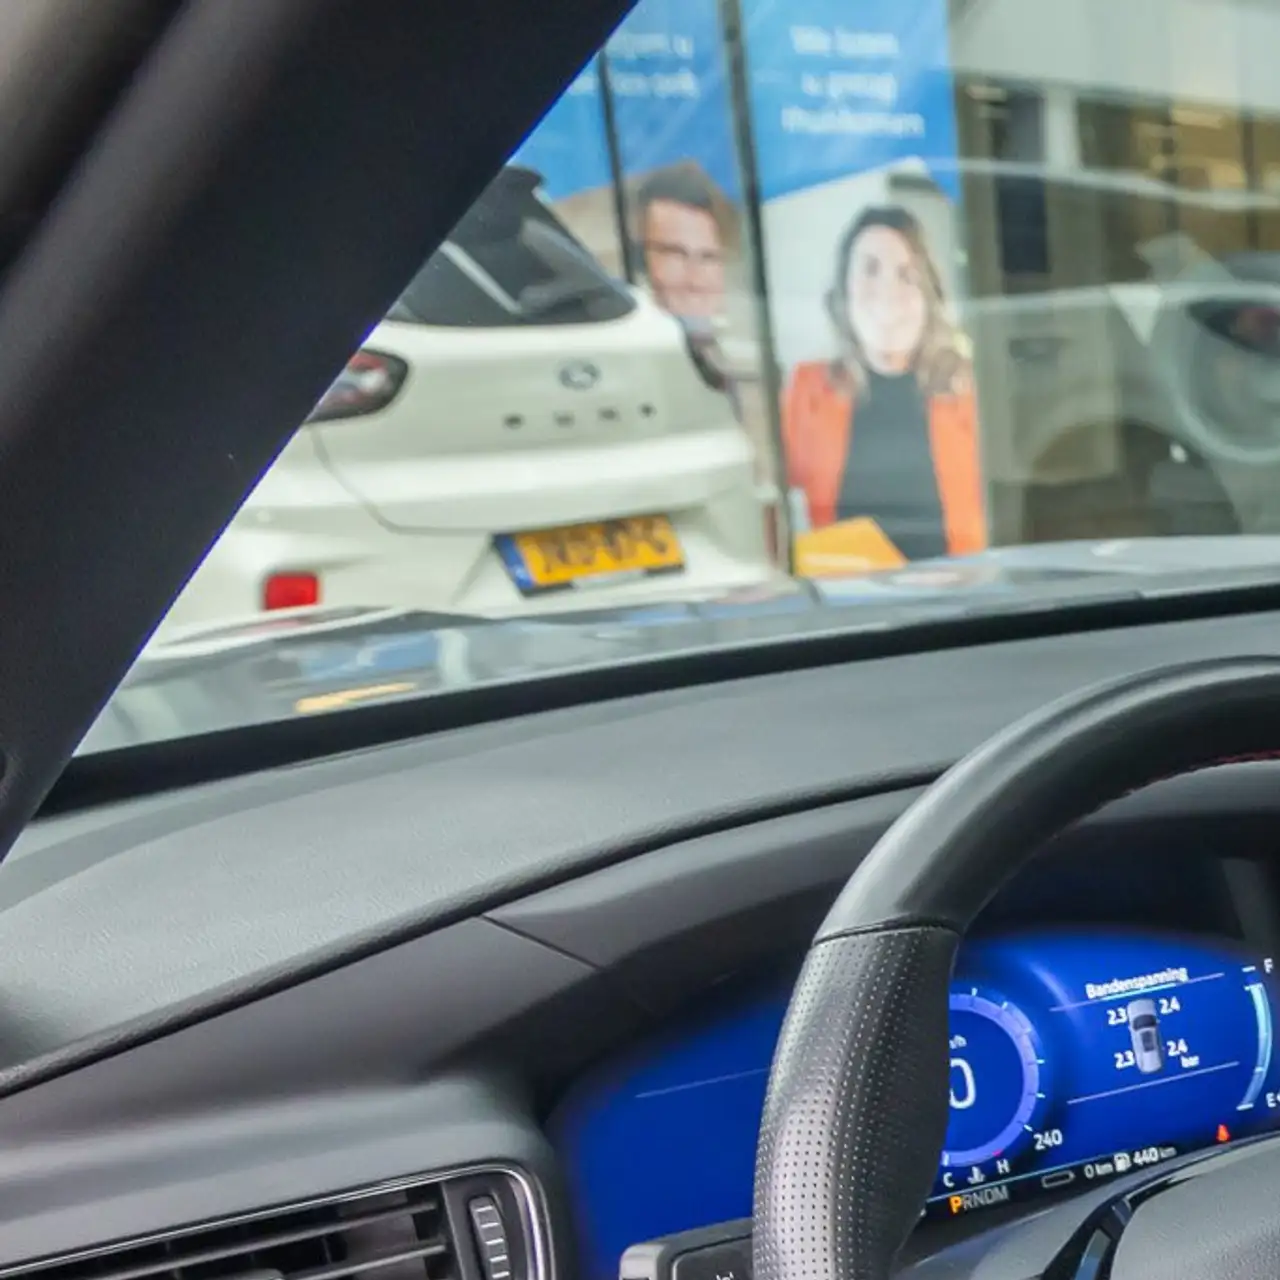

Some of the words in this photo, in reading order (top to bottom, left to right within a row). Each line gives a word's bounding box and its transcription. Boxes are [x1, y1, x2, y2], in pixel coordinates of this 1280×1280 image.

[1263, 957, 1274, 973] F
[1085, 967, 1189, 1000] Bandenspanning
[1265, 1092, 1277, 1108] E
[1033, 1129, 1063, 1150] 240
[1133, 1147, 1160, 1166] 440
[1158, 1146, 1178, 1162] km
[997, 1158, 1010, 1175] H
[1095, 1162, 1114, 1176] km
[943, 1172, 955, 1187] C
